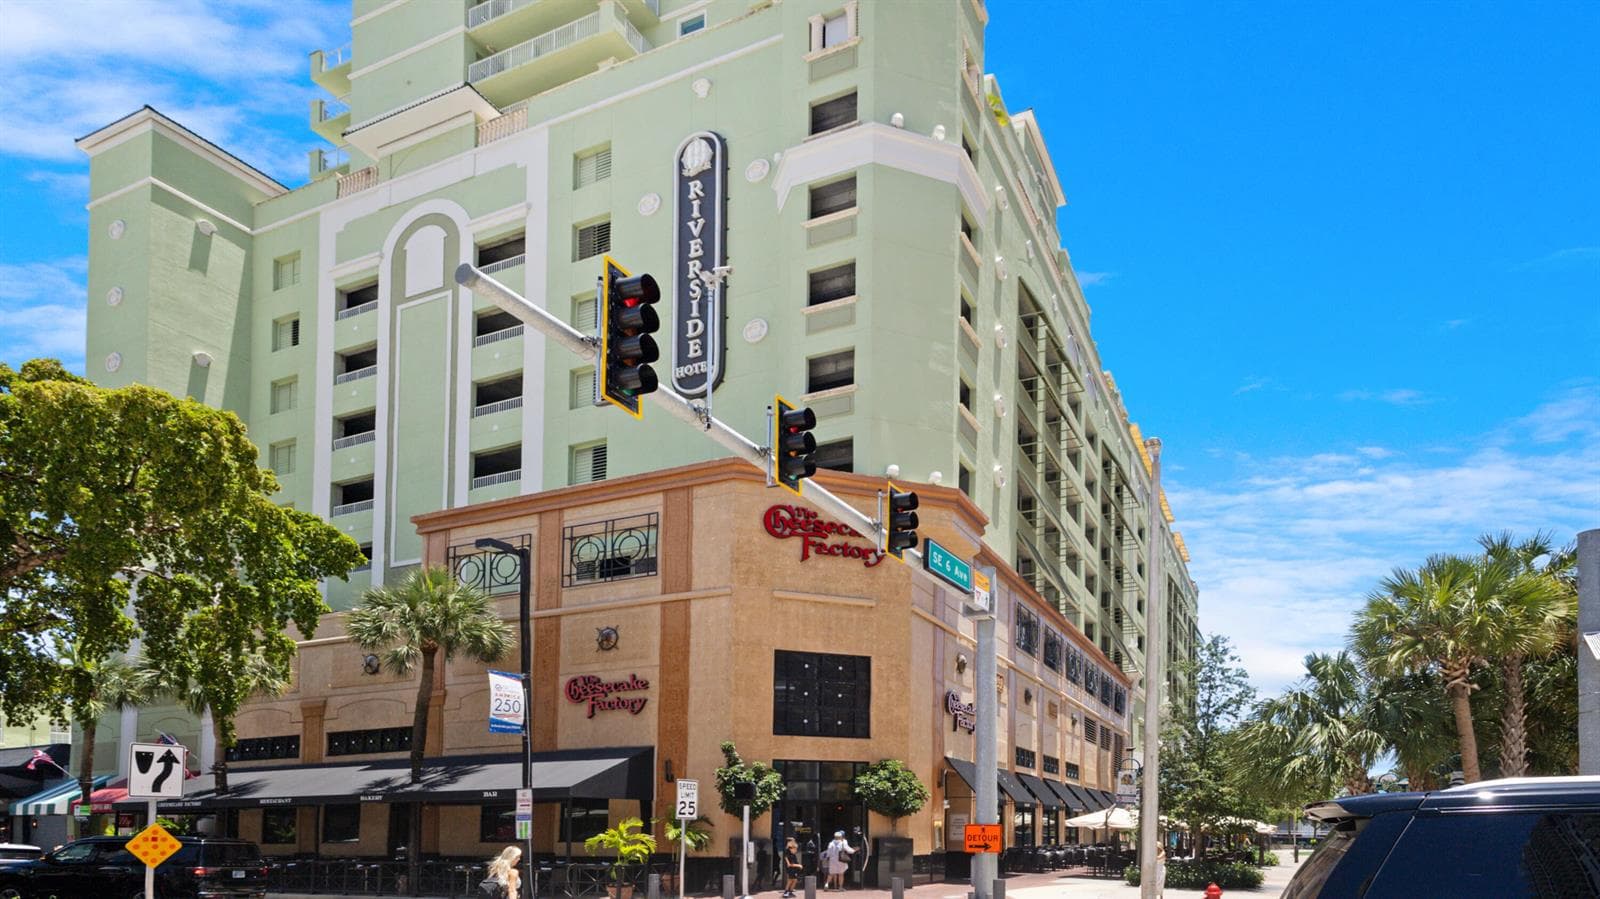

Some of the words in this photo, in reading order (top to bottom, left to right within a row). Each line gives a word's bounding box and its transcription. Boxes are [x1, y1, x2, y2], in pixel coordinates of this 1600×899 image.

[687, 180, 706, 359] RIVERSIDE
[675, 360, 713, 379] HOTE
[791, 531, 886, 568] Factory
[932, 551, 943, 567] SE
[945, 560, 952, 572] 6
[954, 565, 968, 582] Ave
[564, 673, 650, 704] Cheesecake
[495, 698, 521, 713] 250
[586, 694, 649, 720] Factory
[679, 782, 696, 791] SPEED
[680, 791, 695, 799] LIMIT
[678, 800, 696, 816] 25
[967, 834, 999, 843] DETOUR
